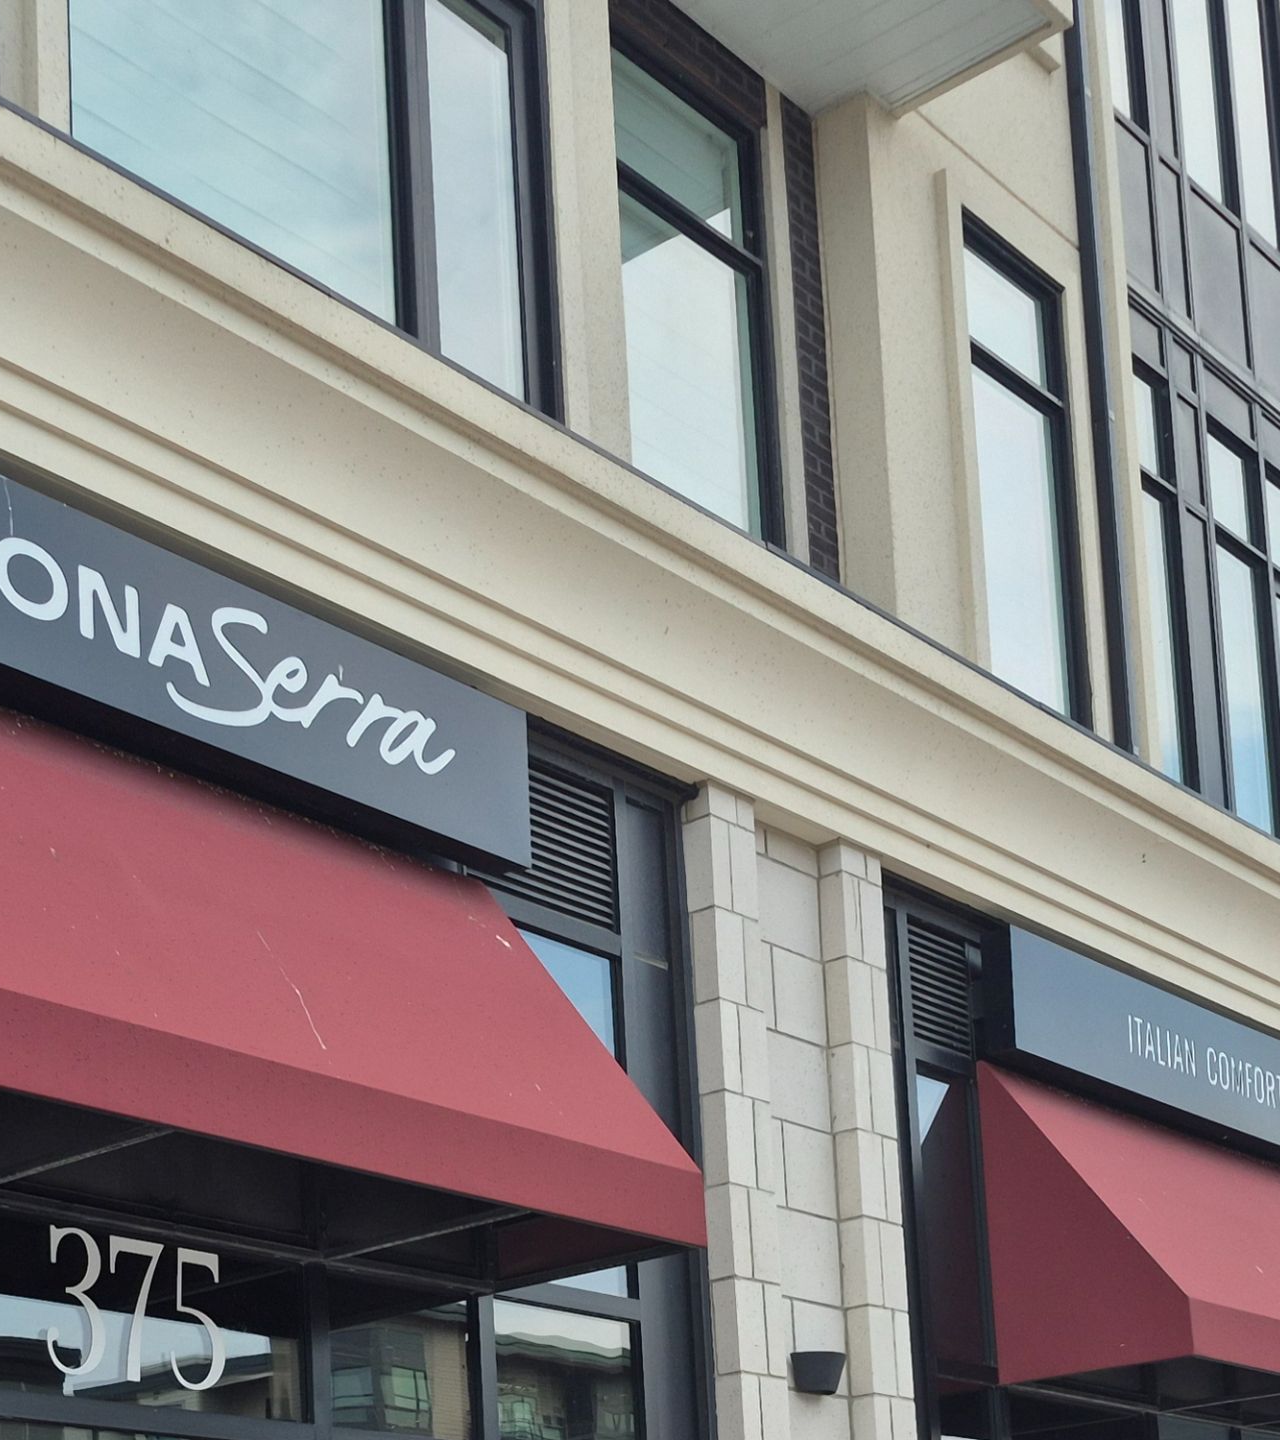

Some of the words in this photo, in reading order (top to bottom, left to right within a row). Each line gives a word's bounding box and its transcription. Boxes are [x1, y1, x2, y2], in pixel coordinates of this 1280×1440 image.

[166, 606, 456, 776] Serra
[1127, 1014, 1197, 1079] ITALIAN
[46, 1224, 227, 1391] 375
